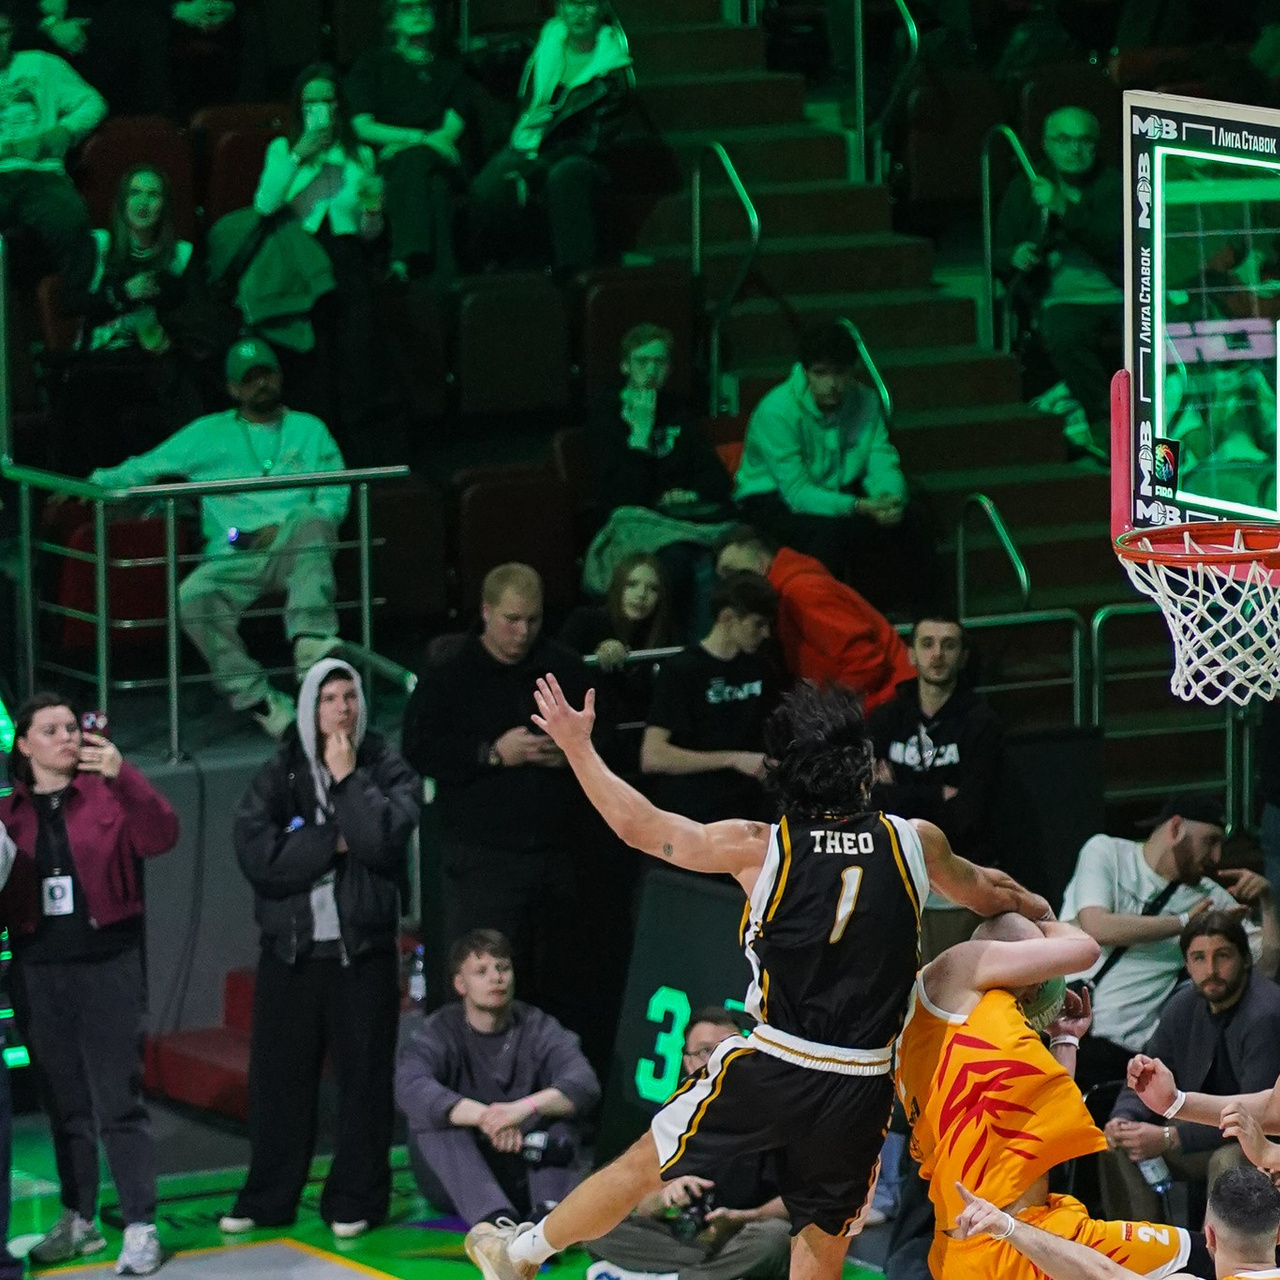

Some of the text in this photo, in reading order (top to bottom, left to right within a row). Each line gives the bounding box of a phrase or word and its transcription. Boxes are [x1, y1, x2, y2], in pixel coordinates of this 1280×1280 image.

[810, 830, 874, 855] THEO
[829, 865, 863, 944] 1
[635, 985, 691, 1105] 3
[1137, 1226, 1170, 1246] 2
